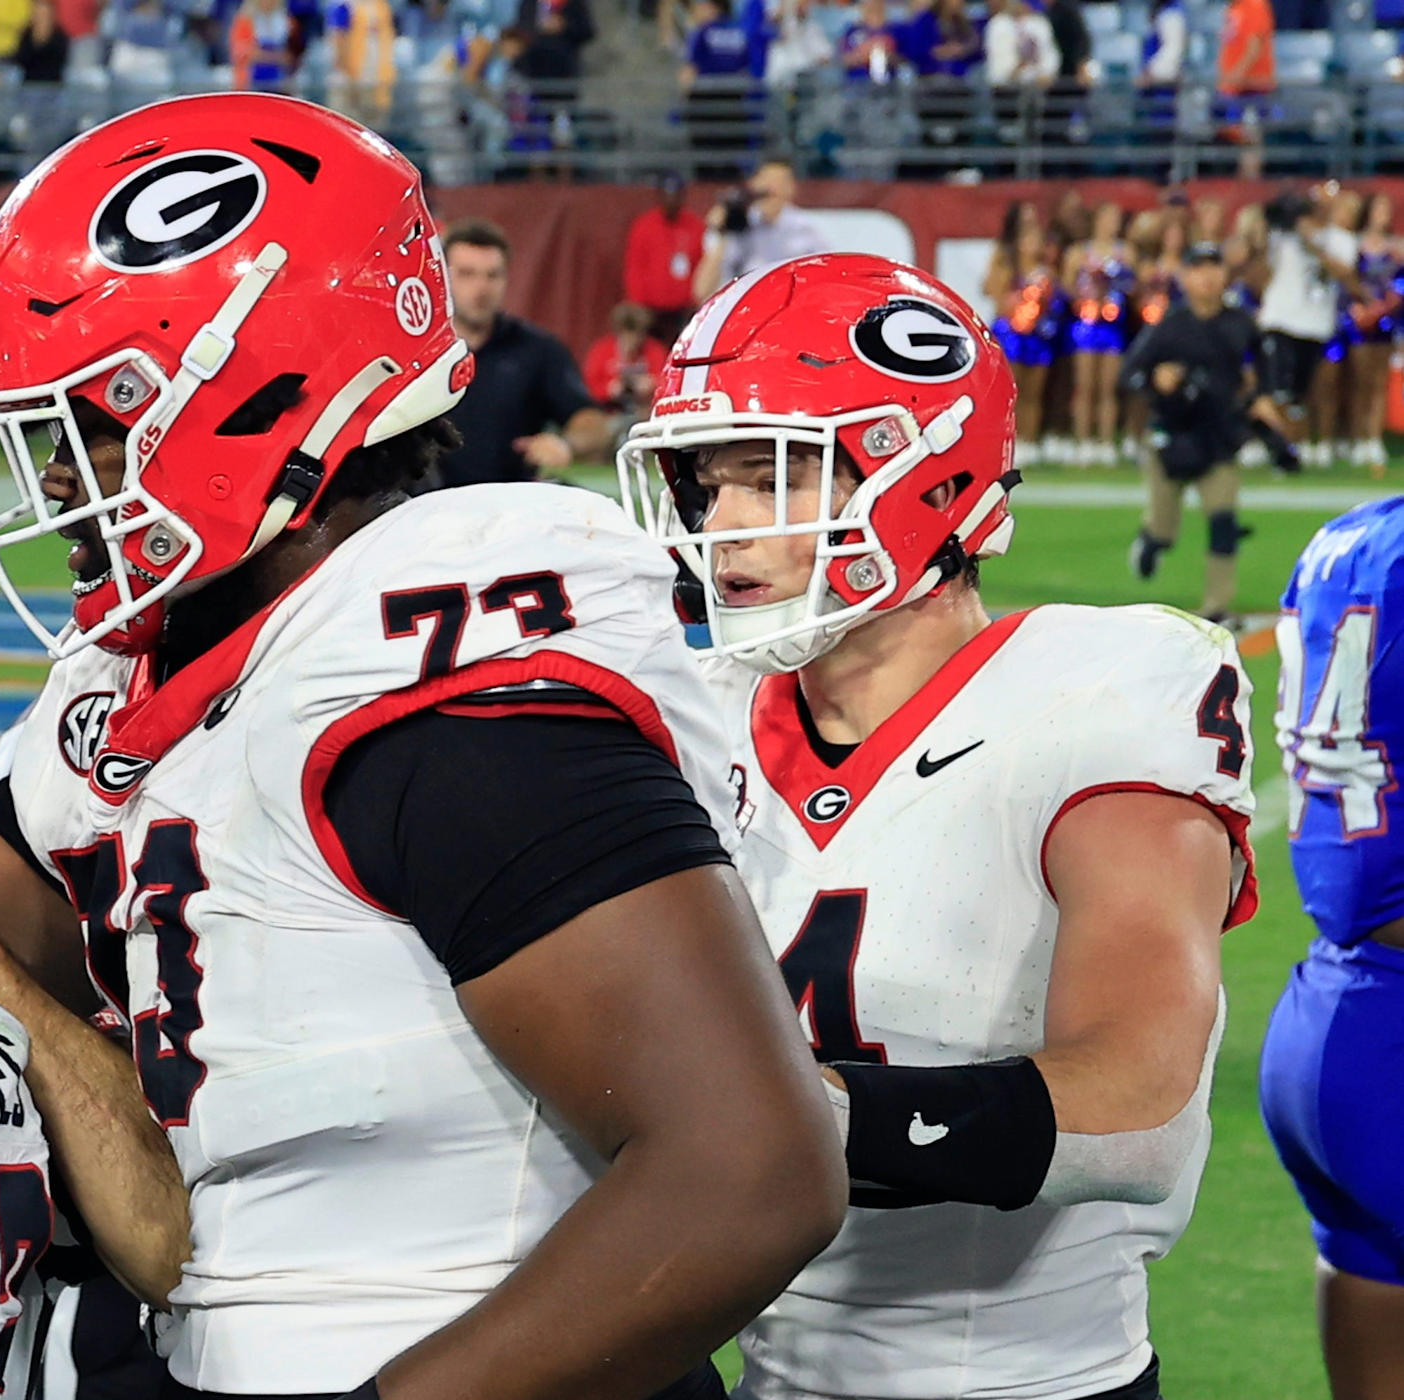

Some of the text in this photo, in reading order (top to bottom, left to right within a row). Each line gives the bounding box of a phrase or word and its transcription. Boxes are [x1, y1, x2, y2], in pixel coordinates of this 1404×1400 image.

[92, 151, 264, 271] G
[850, 296, 974, 380] G
[61, 693, 118, 772] SE
[1195, 663, 1247, 781] 4
[804, 785, 850, 823] G
